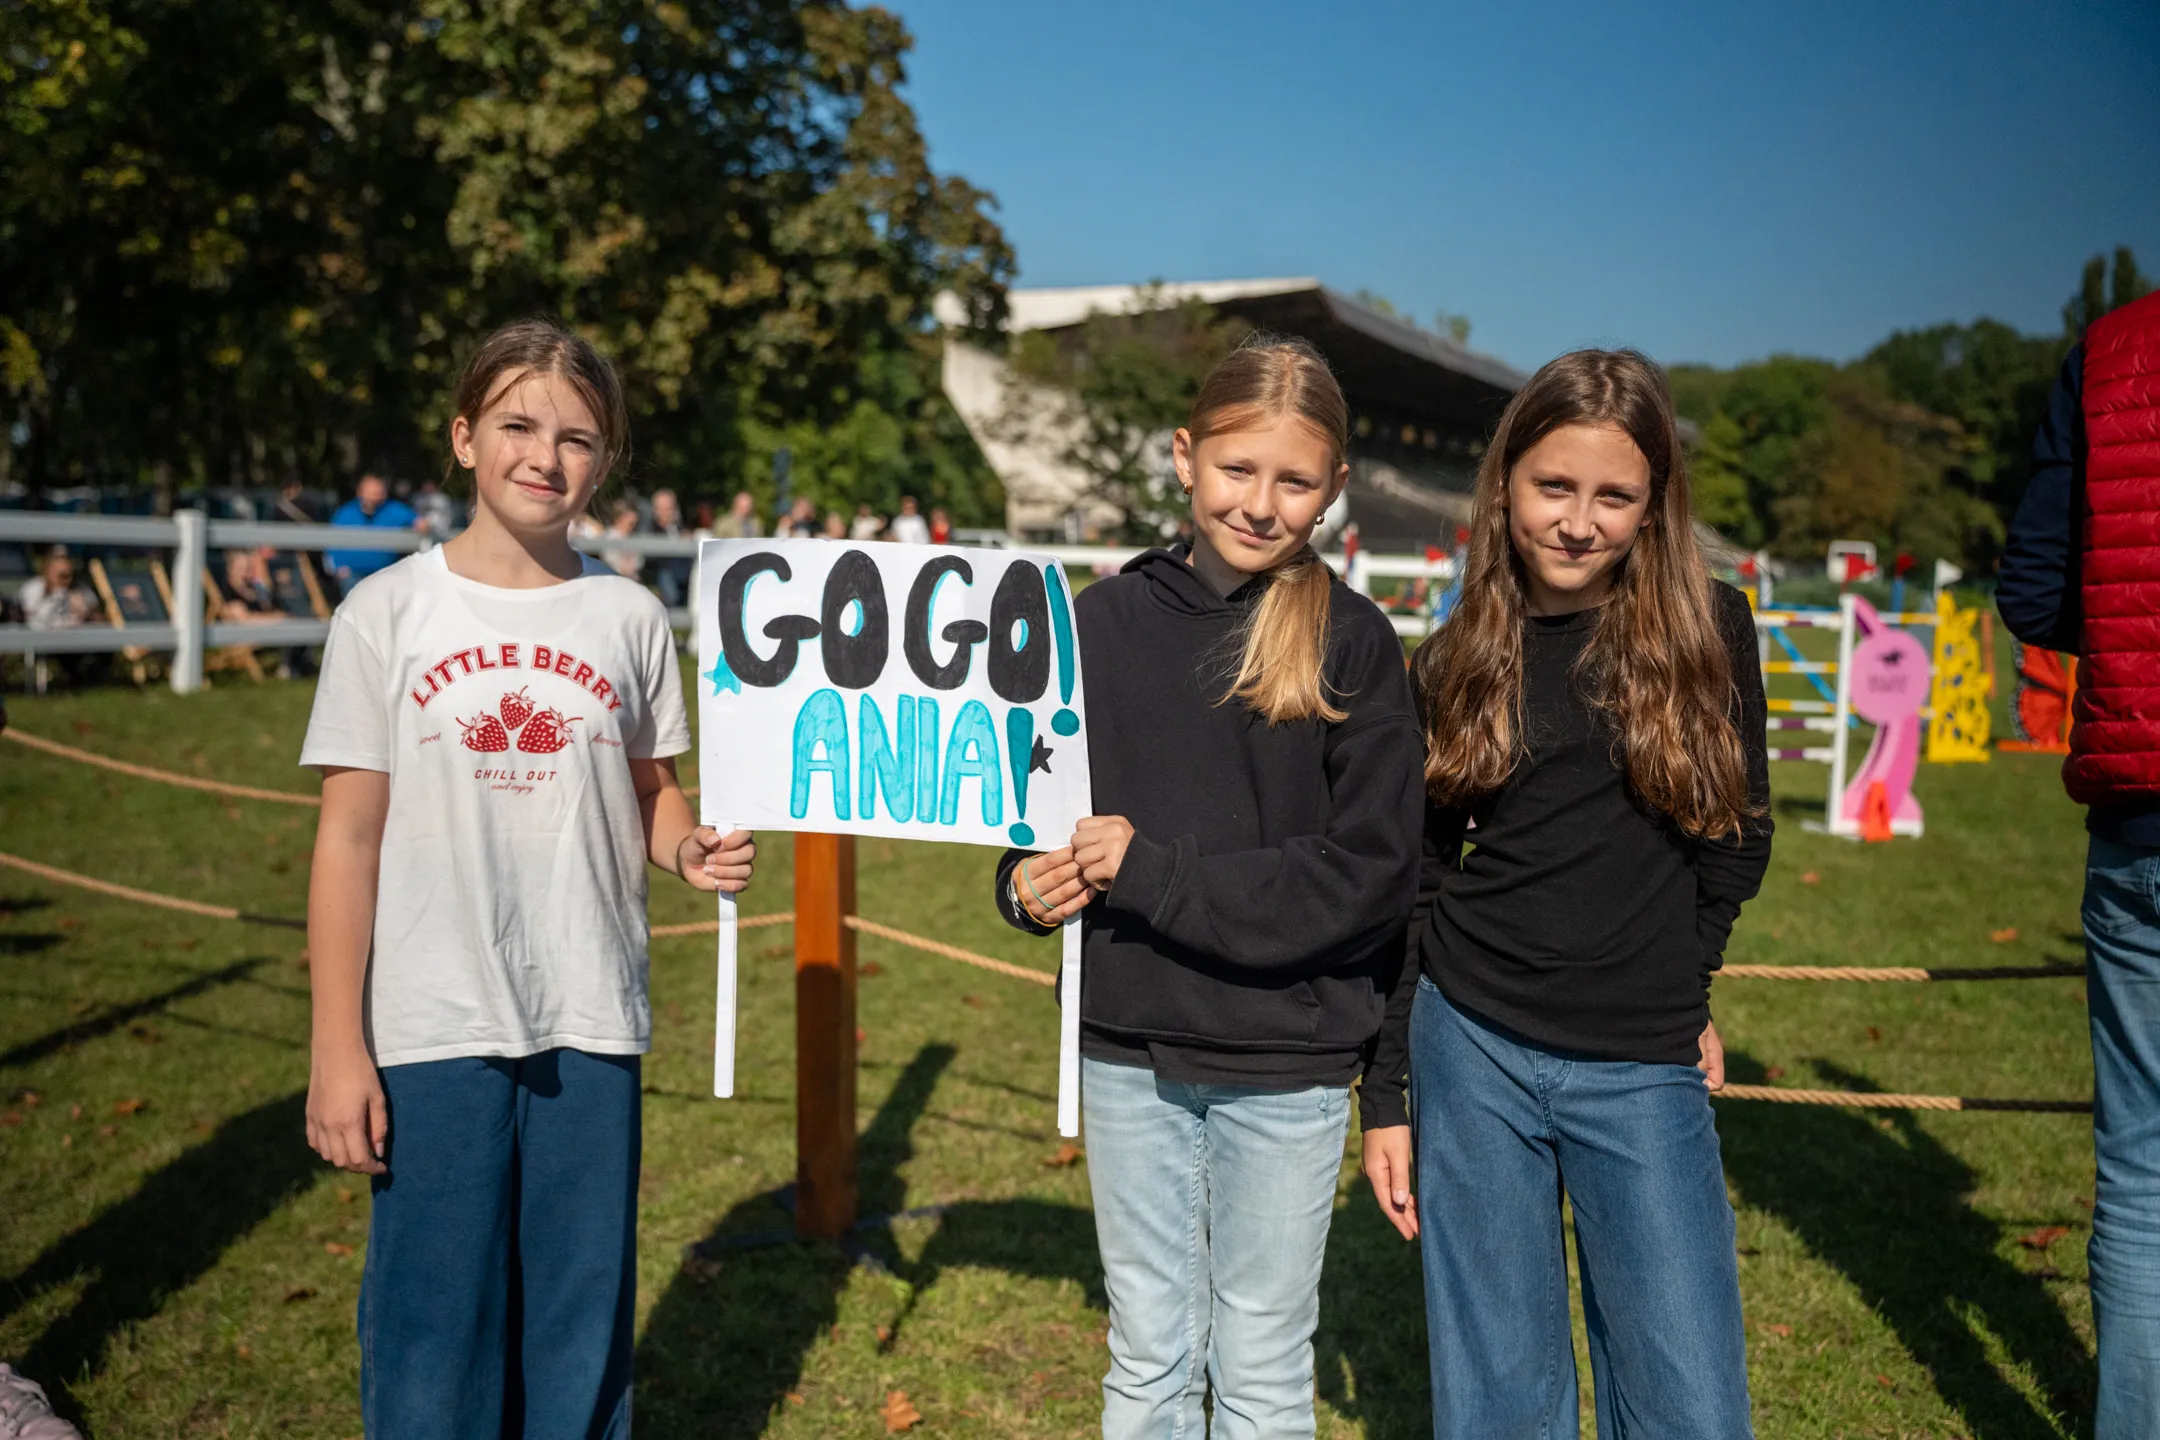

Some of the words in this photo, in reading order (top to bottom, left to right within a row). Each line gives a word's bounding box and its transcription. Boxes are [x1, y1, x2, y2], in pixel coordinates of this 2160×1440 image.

[411, 643, 521, 711] LITTLE
[531, 644, 623, 713] BERRY
[474, 769, 516, 780] CHILL
[526, 770, 557, 781] OUT
[491, 782, 511, 790] and
[790, 688, 1035, 847] ANIA!
